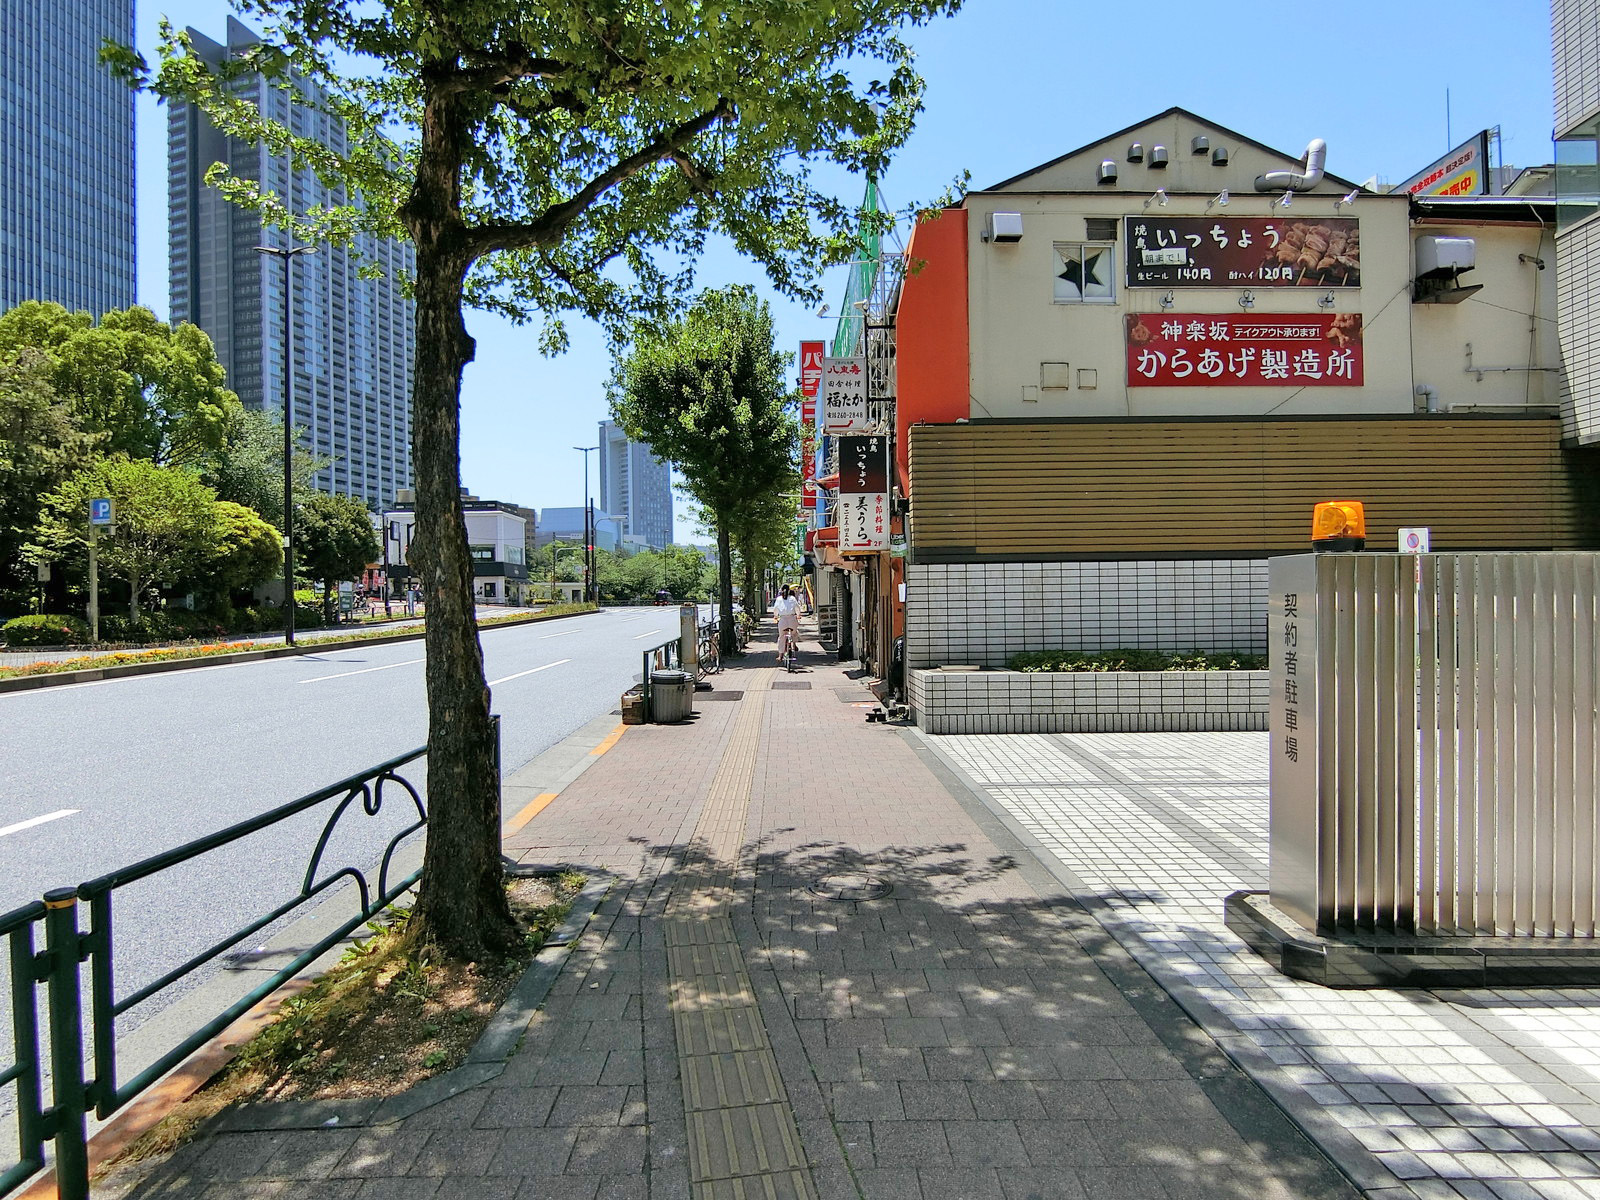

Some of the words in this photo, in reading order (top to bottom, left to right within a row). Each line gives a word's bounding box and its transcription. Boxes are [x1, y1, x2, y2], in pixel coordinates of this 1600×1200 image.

[1134, 225, 1148, 249] 焼鳥
[1156, 224, 1279, 249] いっちょう
[1137, 271, 1169, 280] 生ビール
[1177, 267, 1212, 280] 140円
[1228, 271, 1254, 280] 酎ハイ
[1258, 267, 1293, 280] 120円
[1160, 320, 1230, 341] 神楽坂
[1234, 327, 1320, 337] テイクアウト承ります!
[1136, 347, 1355, 379] からあげ製造所
[826, 392, 864, 408] 福たか
[869, 437, 879, 453] 焼鳥
[856, 445, 867, 487] いっちょう
[99, 502, 110, 518] P
[855, 496, 869, 540] 美うら
[1284, 592, 1299, 763] 契約者駐車場
